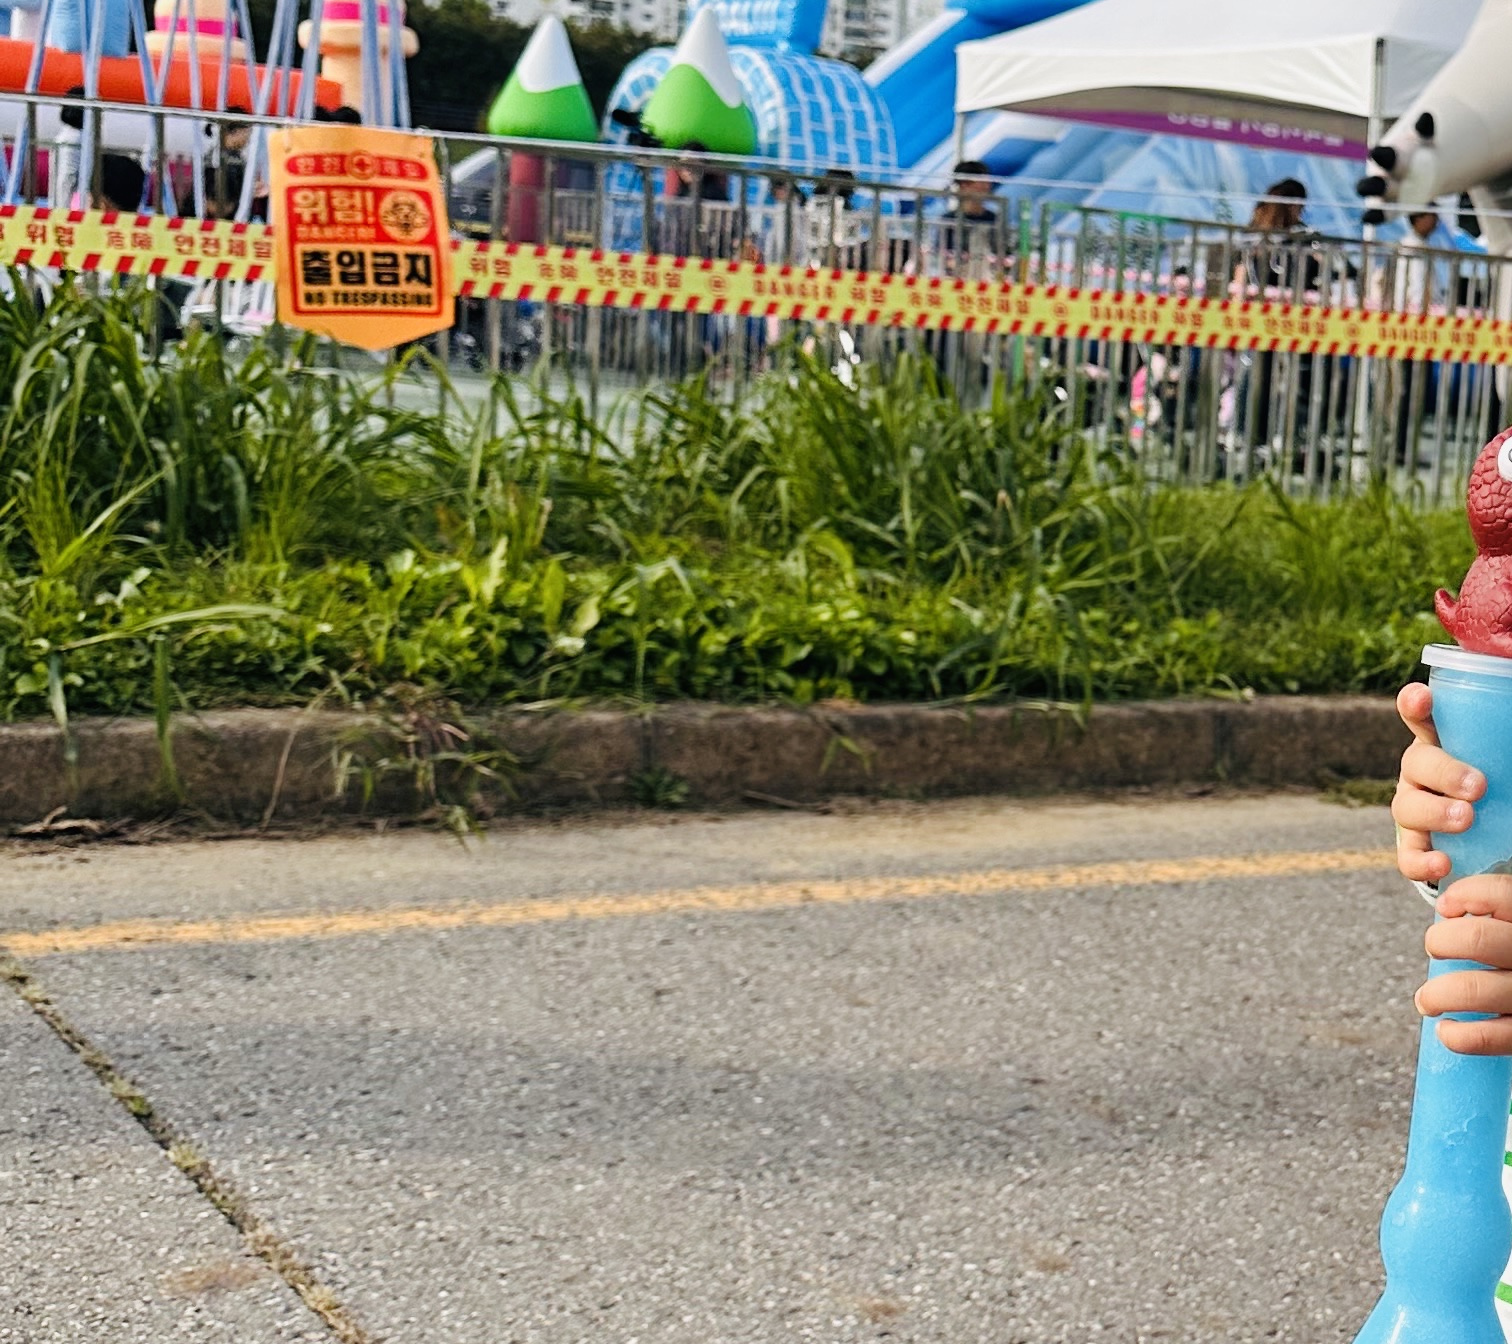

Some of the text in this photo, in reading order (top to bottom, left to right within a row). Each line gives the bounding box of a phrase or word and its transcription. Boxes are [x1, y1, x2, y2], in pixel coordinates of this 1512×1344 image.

[293, 189, 375, 225] 위험!
[26, 223, 75, 247] 위험
[174, 234, 273, 259] 안전제일
[302, 250, 433, 286] 출입금지
